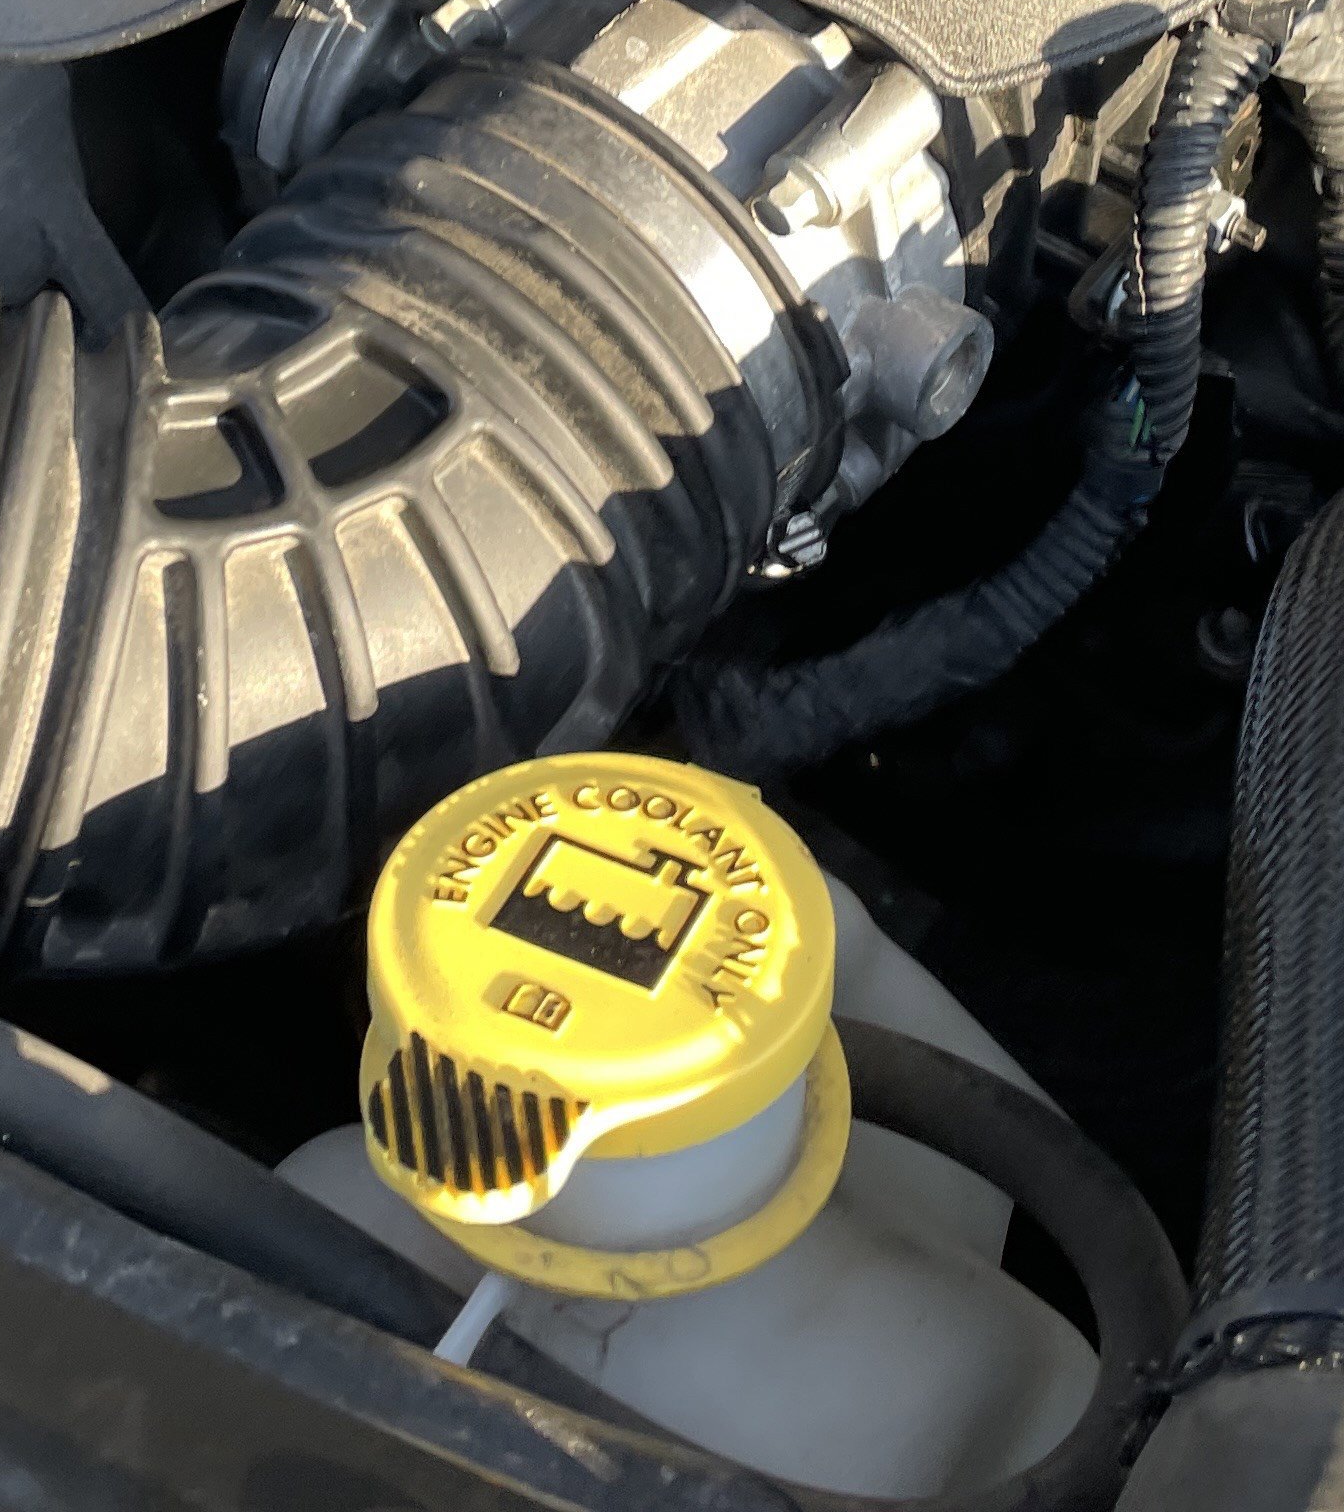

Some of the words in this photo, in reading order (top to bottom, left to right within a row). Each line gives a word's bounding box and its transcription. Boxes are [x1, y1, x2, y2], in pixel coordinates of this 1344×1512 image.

[433, 792, 557, 904] ENGINE
[572, 783, 768, 895] COOLANT
[702, 908, 770, 1013] ONLY
